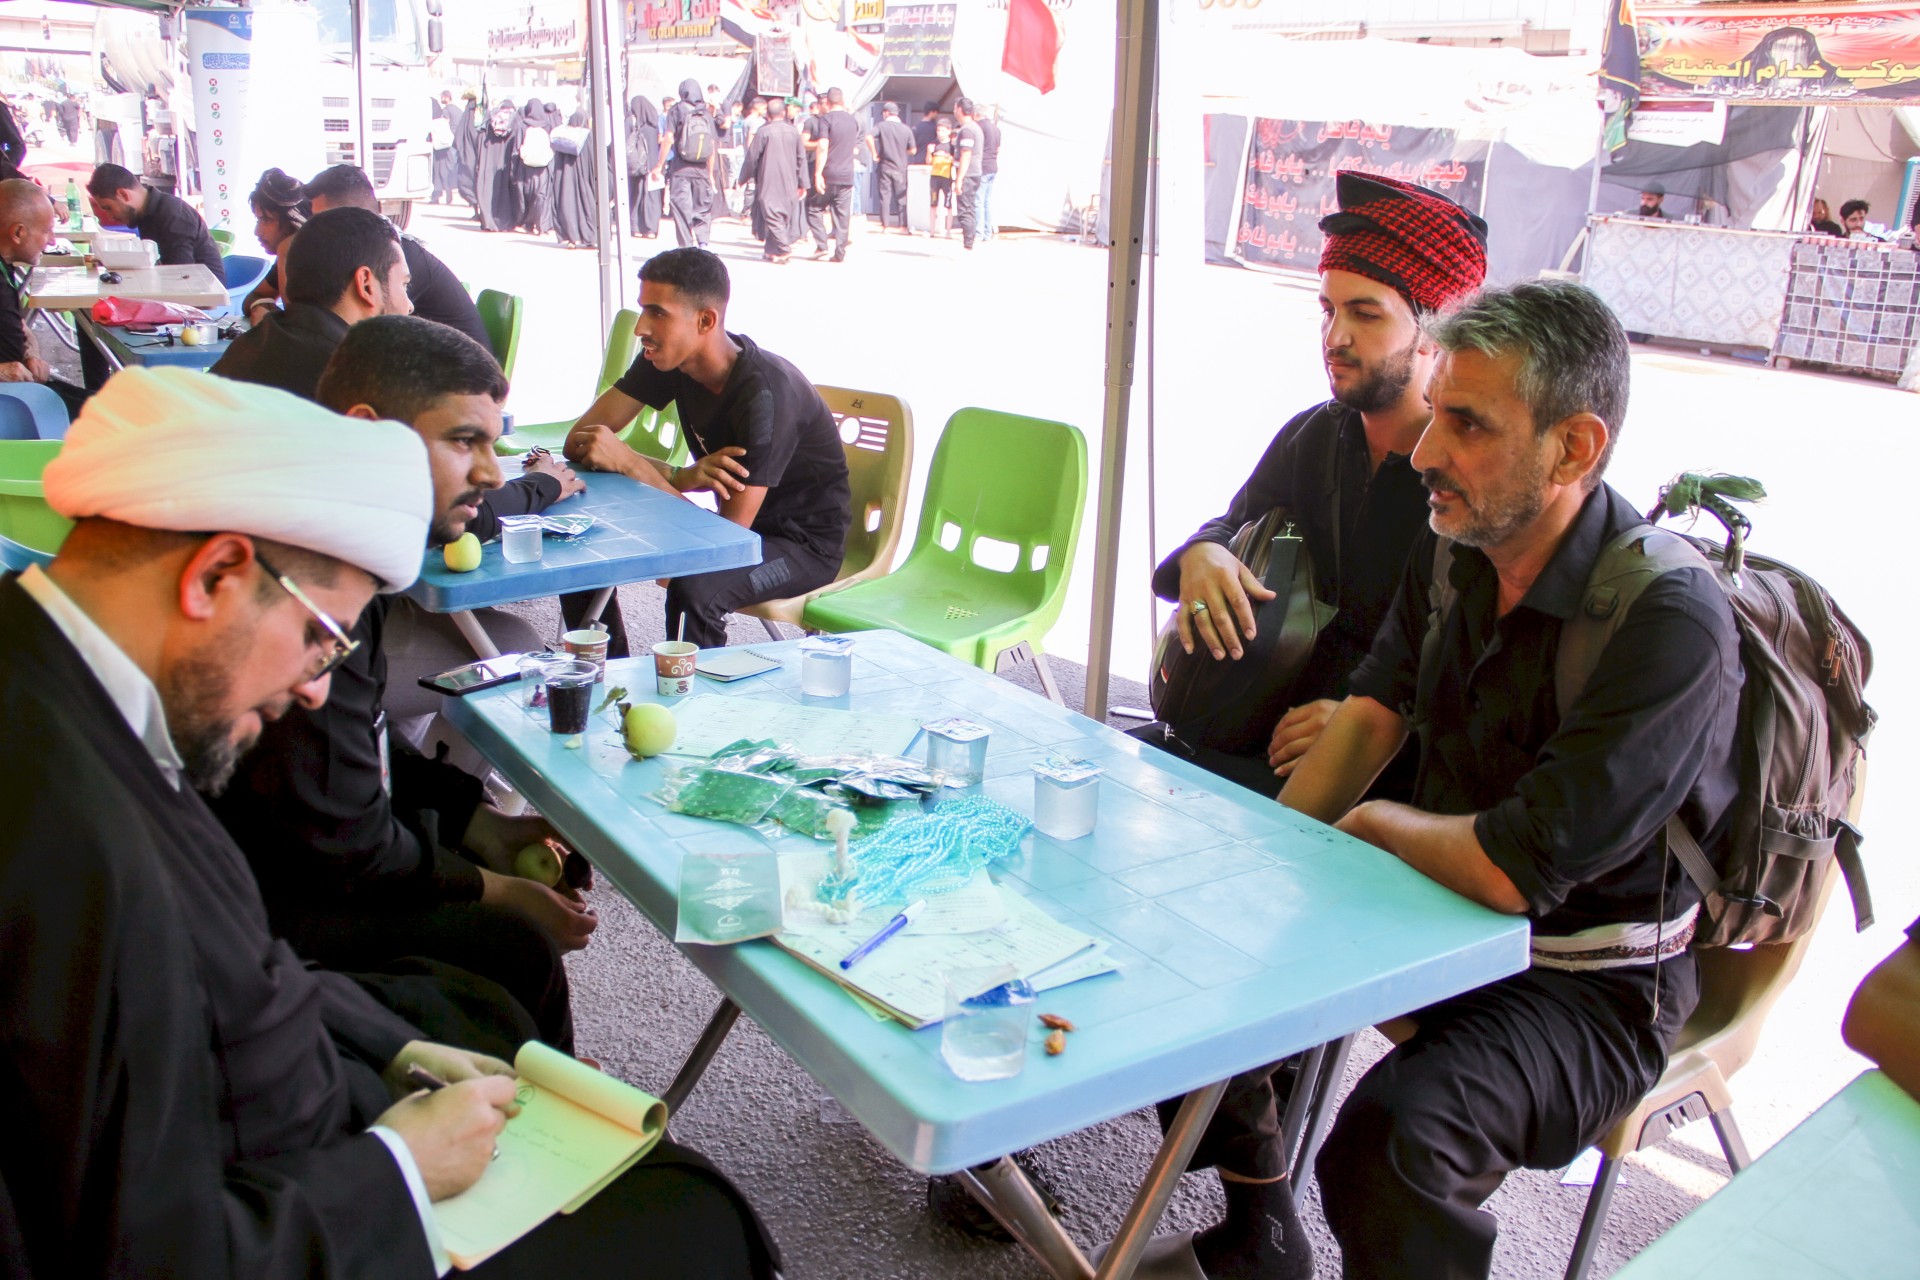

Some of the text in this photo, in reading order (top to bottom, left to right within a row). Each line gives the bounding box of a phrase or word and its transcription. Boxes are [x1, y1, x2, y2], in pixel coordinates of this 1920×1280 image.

[1702, 21, 1723, 31] الله
[1789, 15, 1831, 26] عليك
[1832, 15, 1884, 28] السلام
[658, 26, 676, 39] CREAM
[1662, 58, 1920, 83] موكب خدام العقيلة
[1693, 83, 1859, 99] خدمة الزوار شرف لنا
